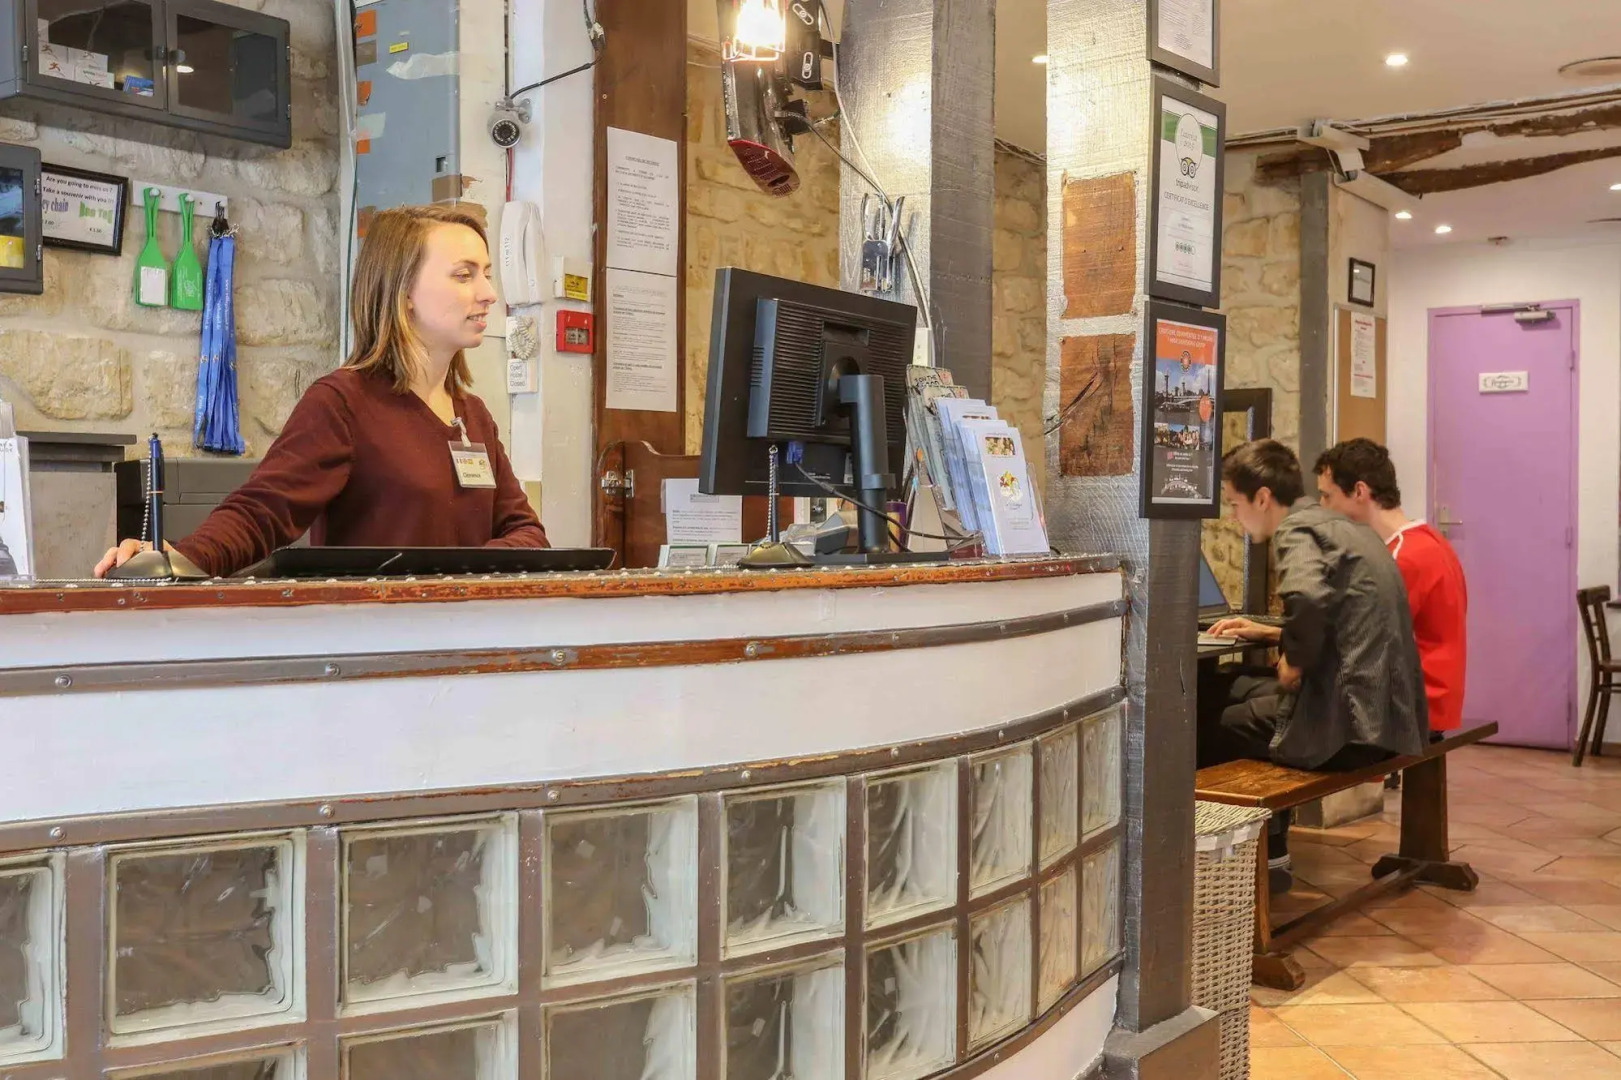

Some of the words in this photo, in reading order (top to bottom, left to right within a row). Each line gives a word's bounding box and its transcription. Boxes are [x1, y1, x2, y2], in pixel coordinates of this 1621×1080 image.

[68, 180, 82, 188] going
[43, 186, 55, 194] Take
[61, 191, 84, 199] souvenir
[84, 194, 97, 202] with
[51, 197, 69, 213] chain
